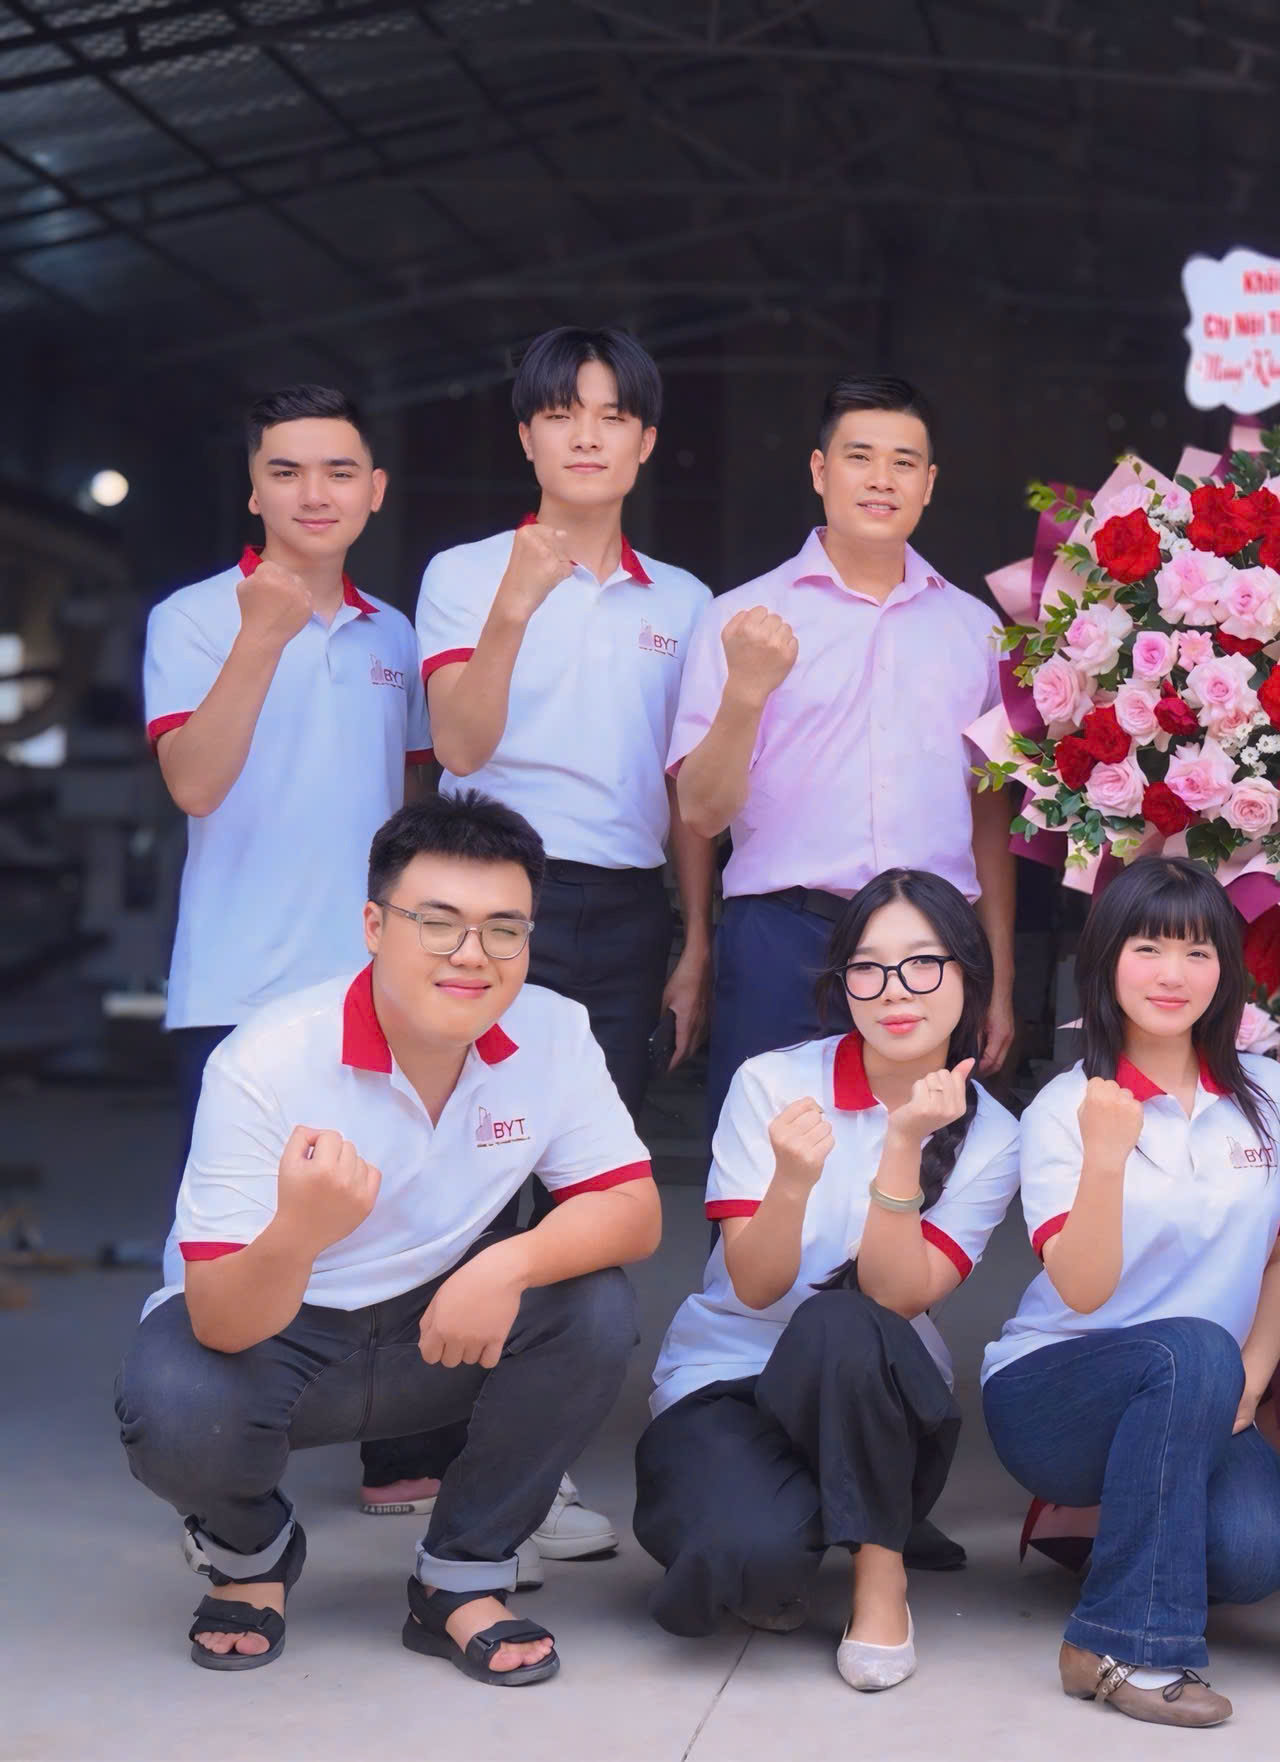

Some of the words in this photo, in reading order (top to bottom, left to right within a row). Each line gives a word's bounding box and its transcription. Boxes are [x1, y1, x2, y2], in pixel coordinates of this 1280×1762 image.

[653, 634, 679, 654] BYT
[383, 668, 405, 686] BYT
[493, 1118, 526, 1139] BYT
[1244, 1147, 1273, 1163] BYT
